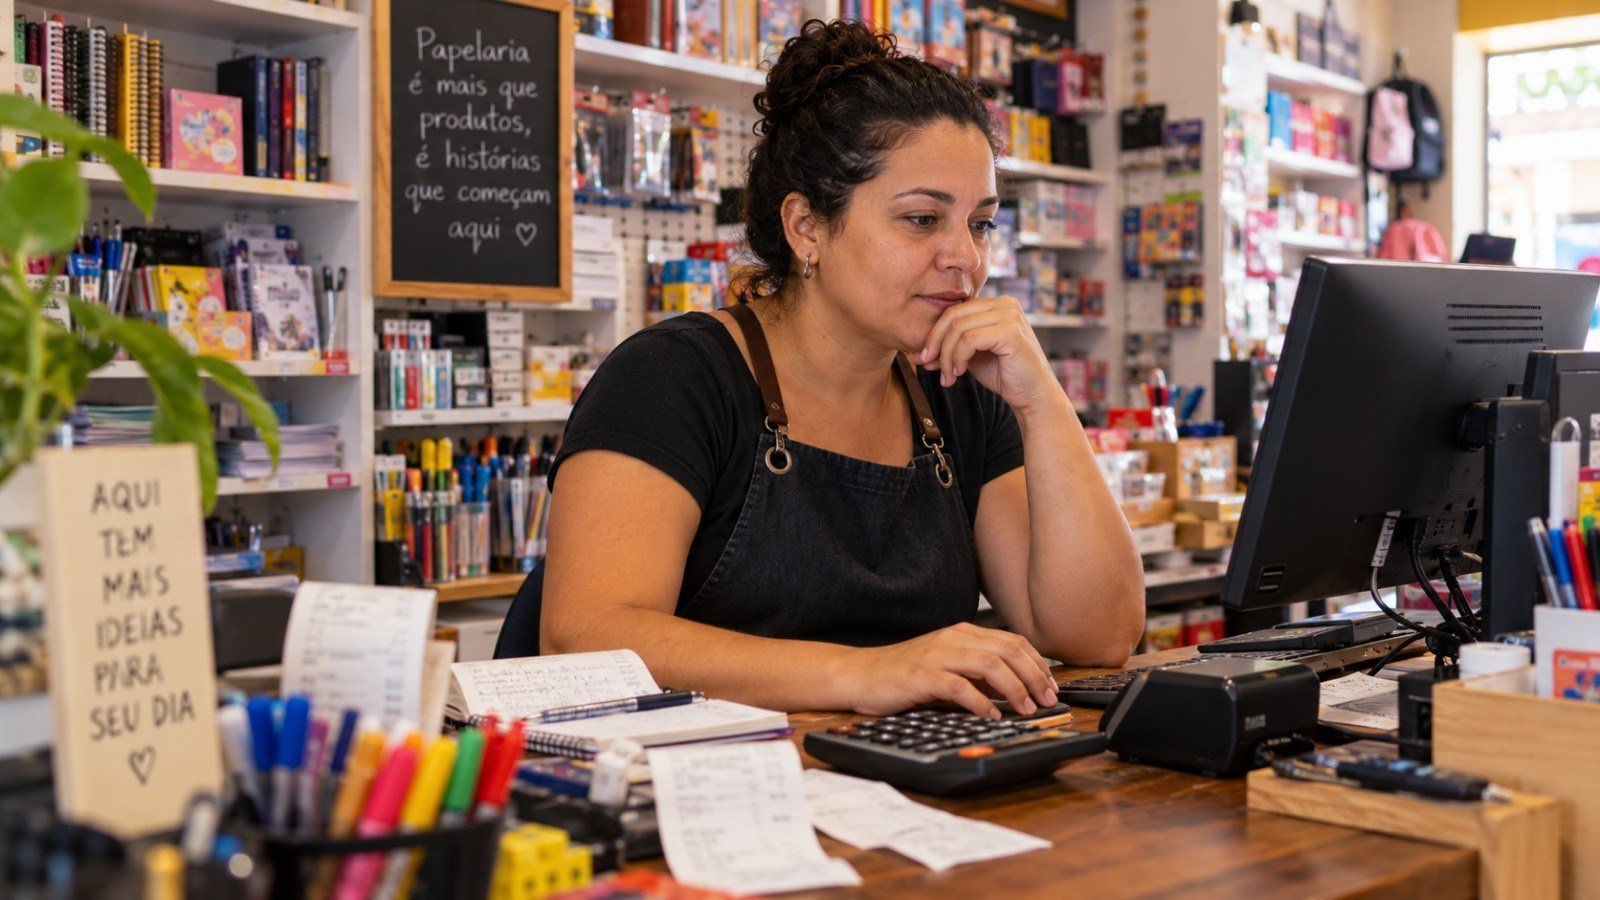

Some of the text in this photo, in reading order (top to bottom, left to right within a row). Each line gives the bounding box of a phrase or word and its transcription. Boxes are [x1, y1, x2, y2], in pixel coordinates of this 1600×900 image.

[415, 26, 531, 74] Papelaria
[408, 71, 538, 110] é mais que
[420, 102, 532, 140] produtos,
[415, 139, 541, 172] é histórias
[404, 183, 551, 214] que começam
[448, 217, 501, 254] aqui
[91, 480, 160, 514] AQUI
[100, 524, 155, 559] TEM
[102, 565, 170, 602] MAIS
[96, 605, 184, 650] IDEIAS
[93, 653, 164, 693] PARA
[89, 690, 196, 742] SEU DIA
